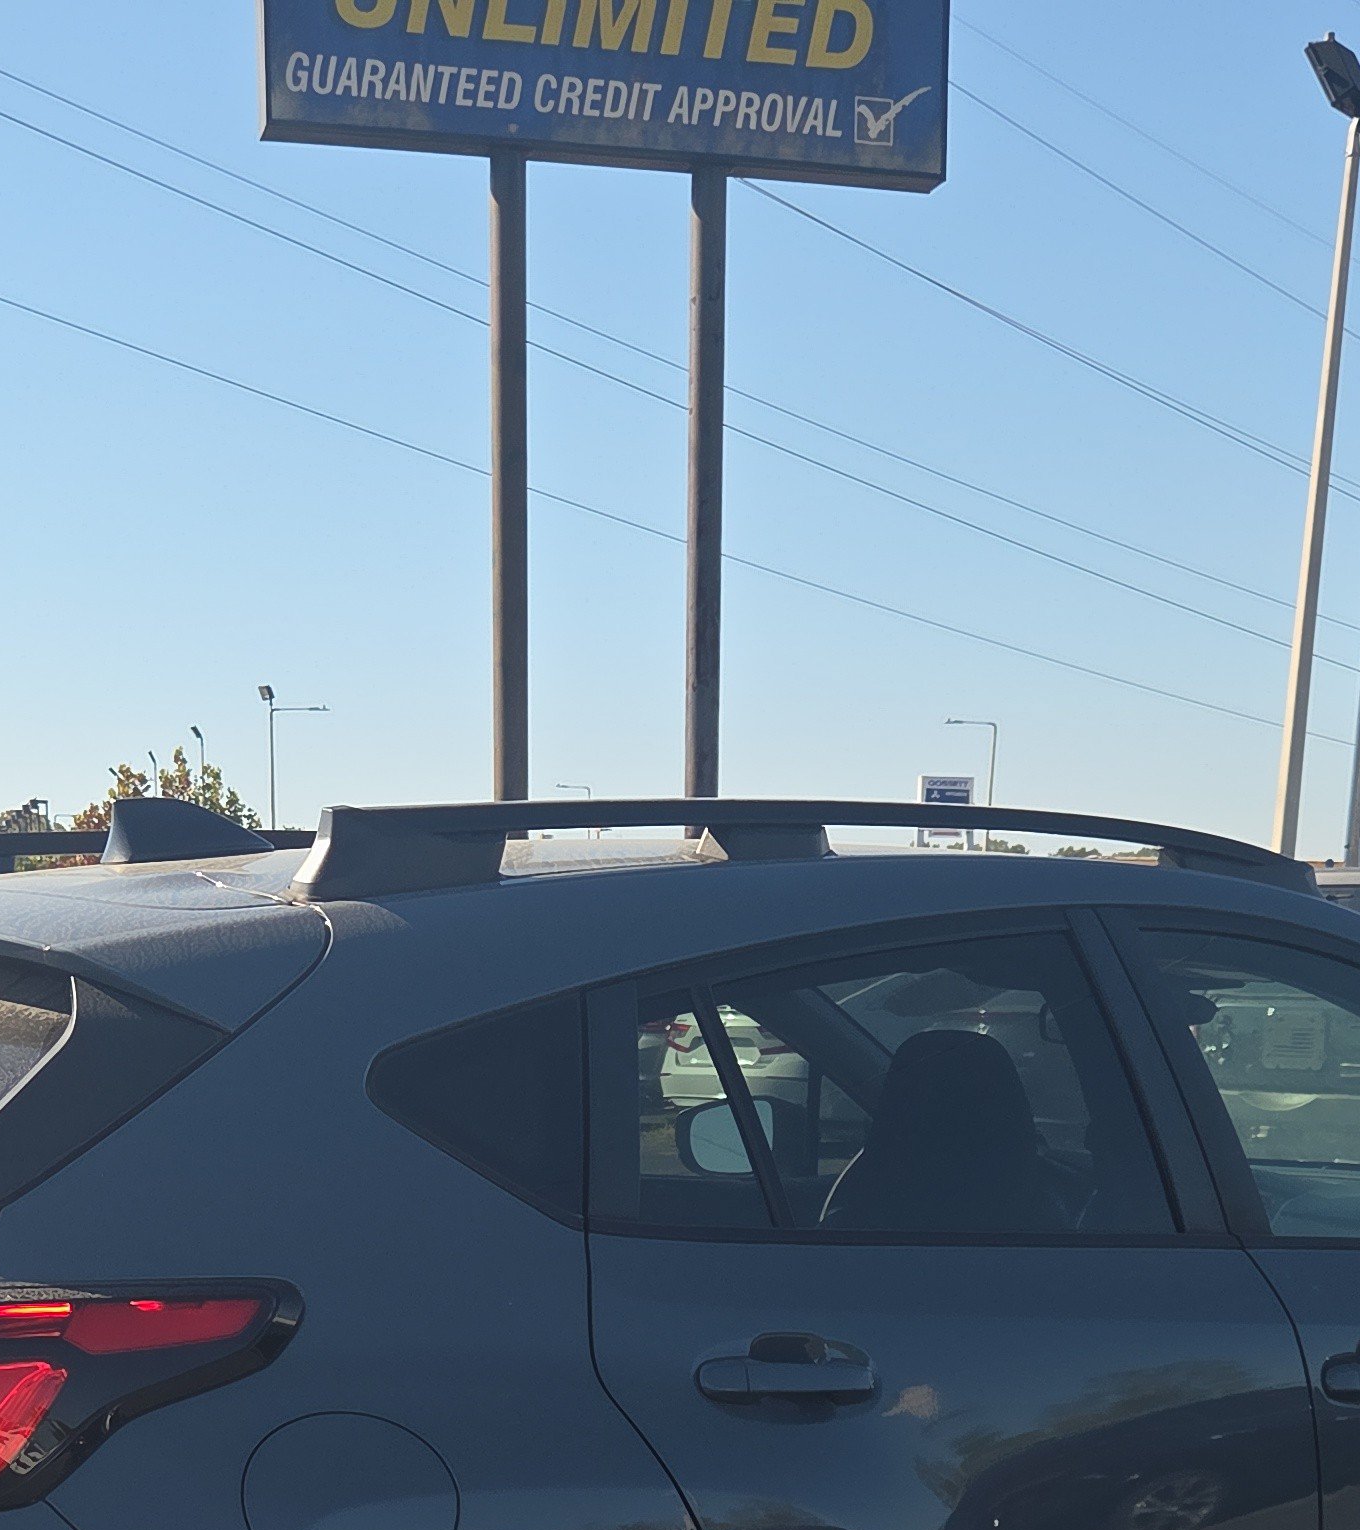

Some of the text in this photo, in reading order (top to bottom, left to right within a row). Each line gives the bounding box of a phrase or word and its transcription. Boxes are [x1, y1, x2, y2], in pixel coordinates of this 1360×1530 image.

[285, 51, 842, 138] GUARANTEED CREDIT APPROVAL
